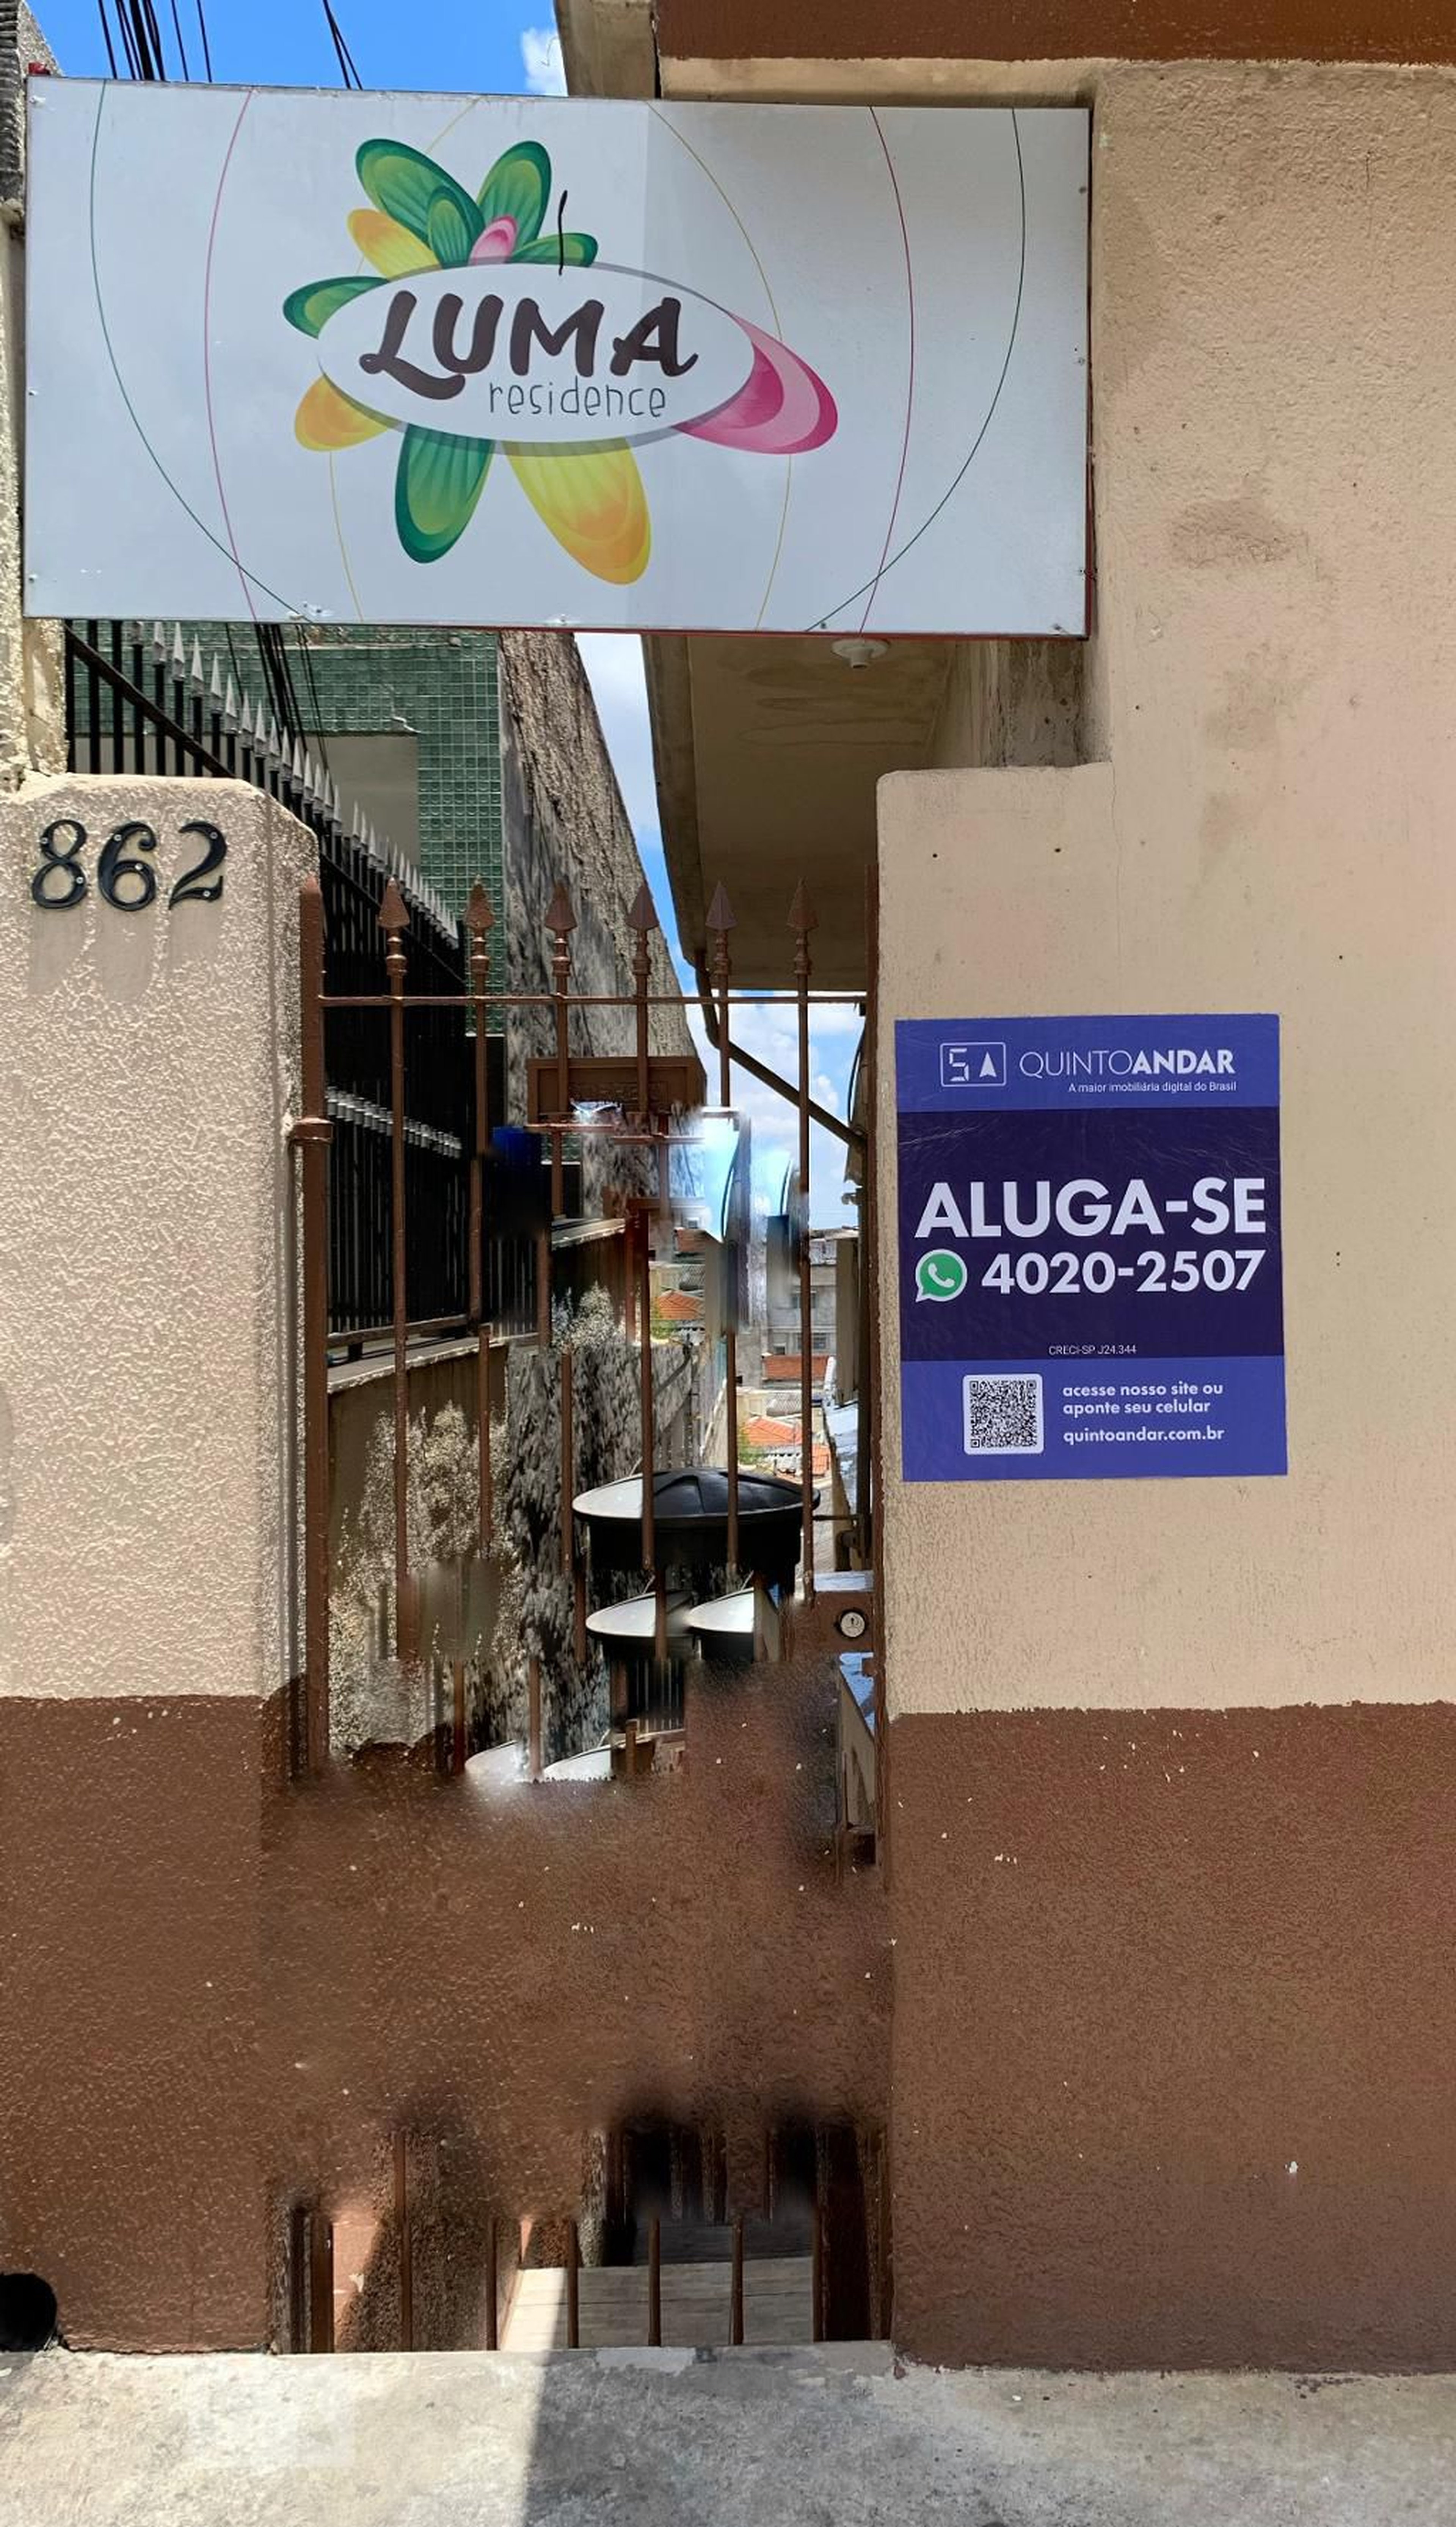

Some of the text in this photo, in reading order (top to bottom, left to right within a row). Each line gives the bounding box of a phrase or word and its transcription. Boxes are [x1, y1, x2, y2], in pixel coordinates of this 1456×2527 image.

[358, 290, 698, 400] LUMA
[489, 376, 665, 417] residence
[32, 819, 227, 911] 862
[1020, 1049, 1235, 1078] QUINTOANDAR
[1068, 1083, 1076, 1092] A
[1078, 1083, 1106, 1092] maior
[1162, 1081, 1192, 1094] digital
[1194, 1081, 1207, 1091] do
[1209, 1081, 1236, 1091] Brasil
[915, 1177, 1266, 1238] ALUGA-SE
[982, 1250, 1266, 1294] 4020-2507
[1063, 1381, 1223, 1396] acesse nosso site ou
[1063, 1398, 1210, 1418] aponte seu celular
[1063, 1425, 1224, 1445] quintoandar.com.br
